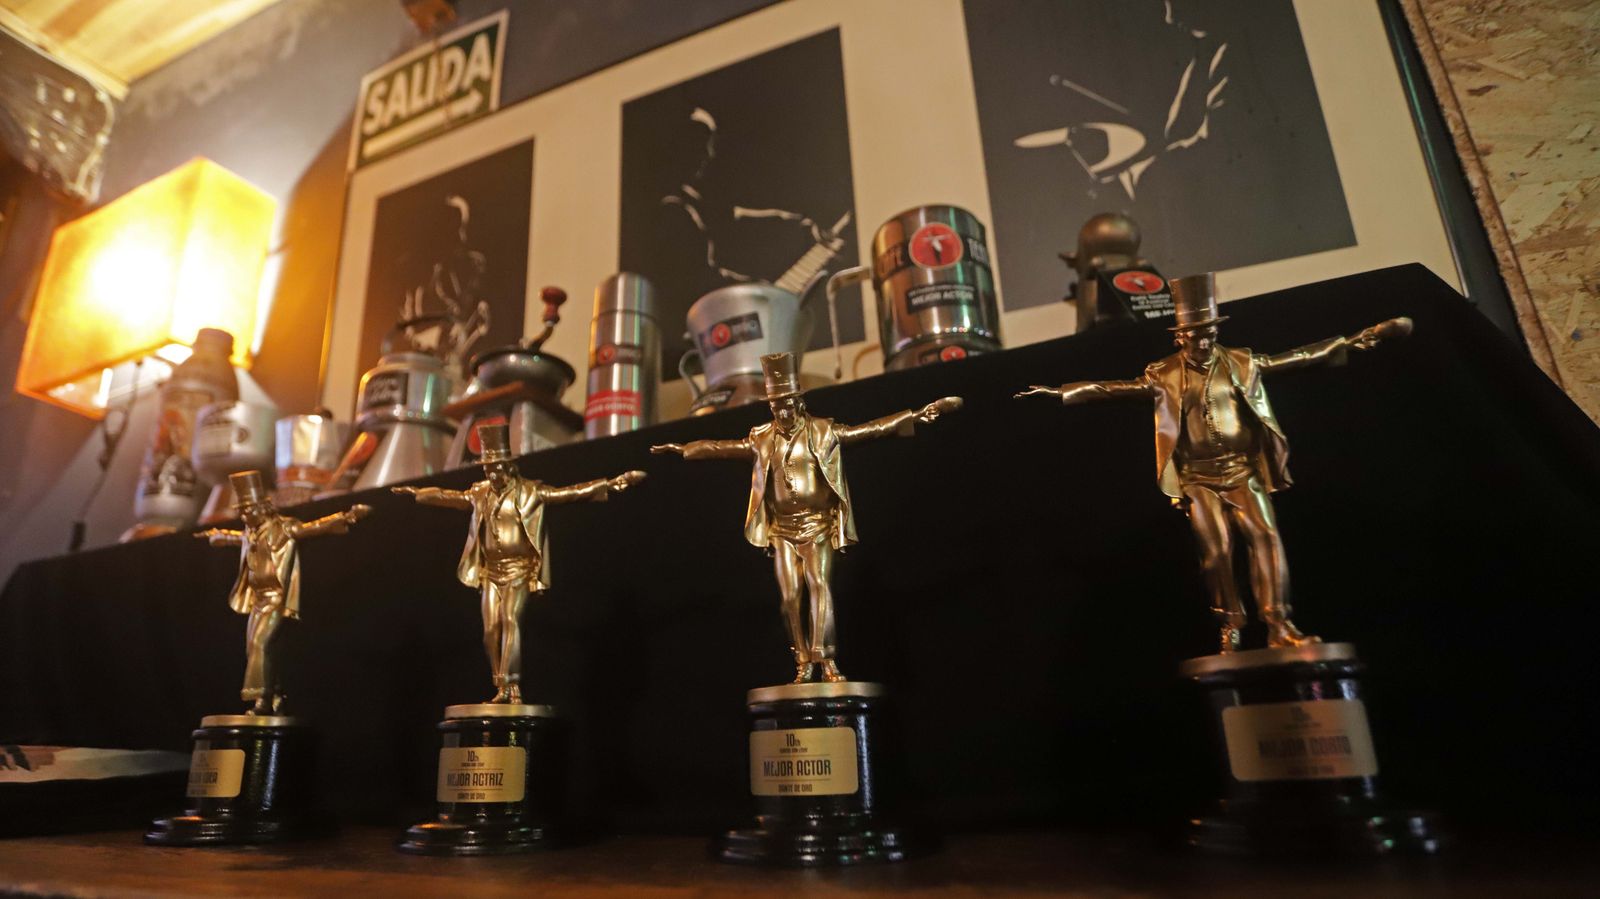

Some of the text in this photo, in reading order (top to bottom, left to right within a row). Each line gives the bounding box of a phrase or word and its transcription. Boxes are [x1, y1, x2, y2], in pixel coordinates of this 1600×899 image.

[362, 32, 493, 135] SALIDA
[942, 288, 974, 301] ACTOR
[764, 759, 831, 776] MEJOR ACTOR
[473, 773, 503, 786] ACTRIZ
